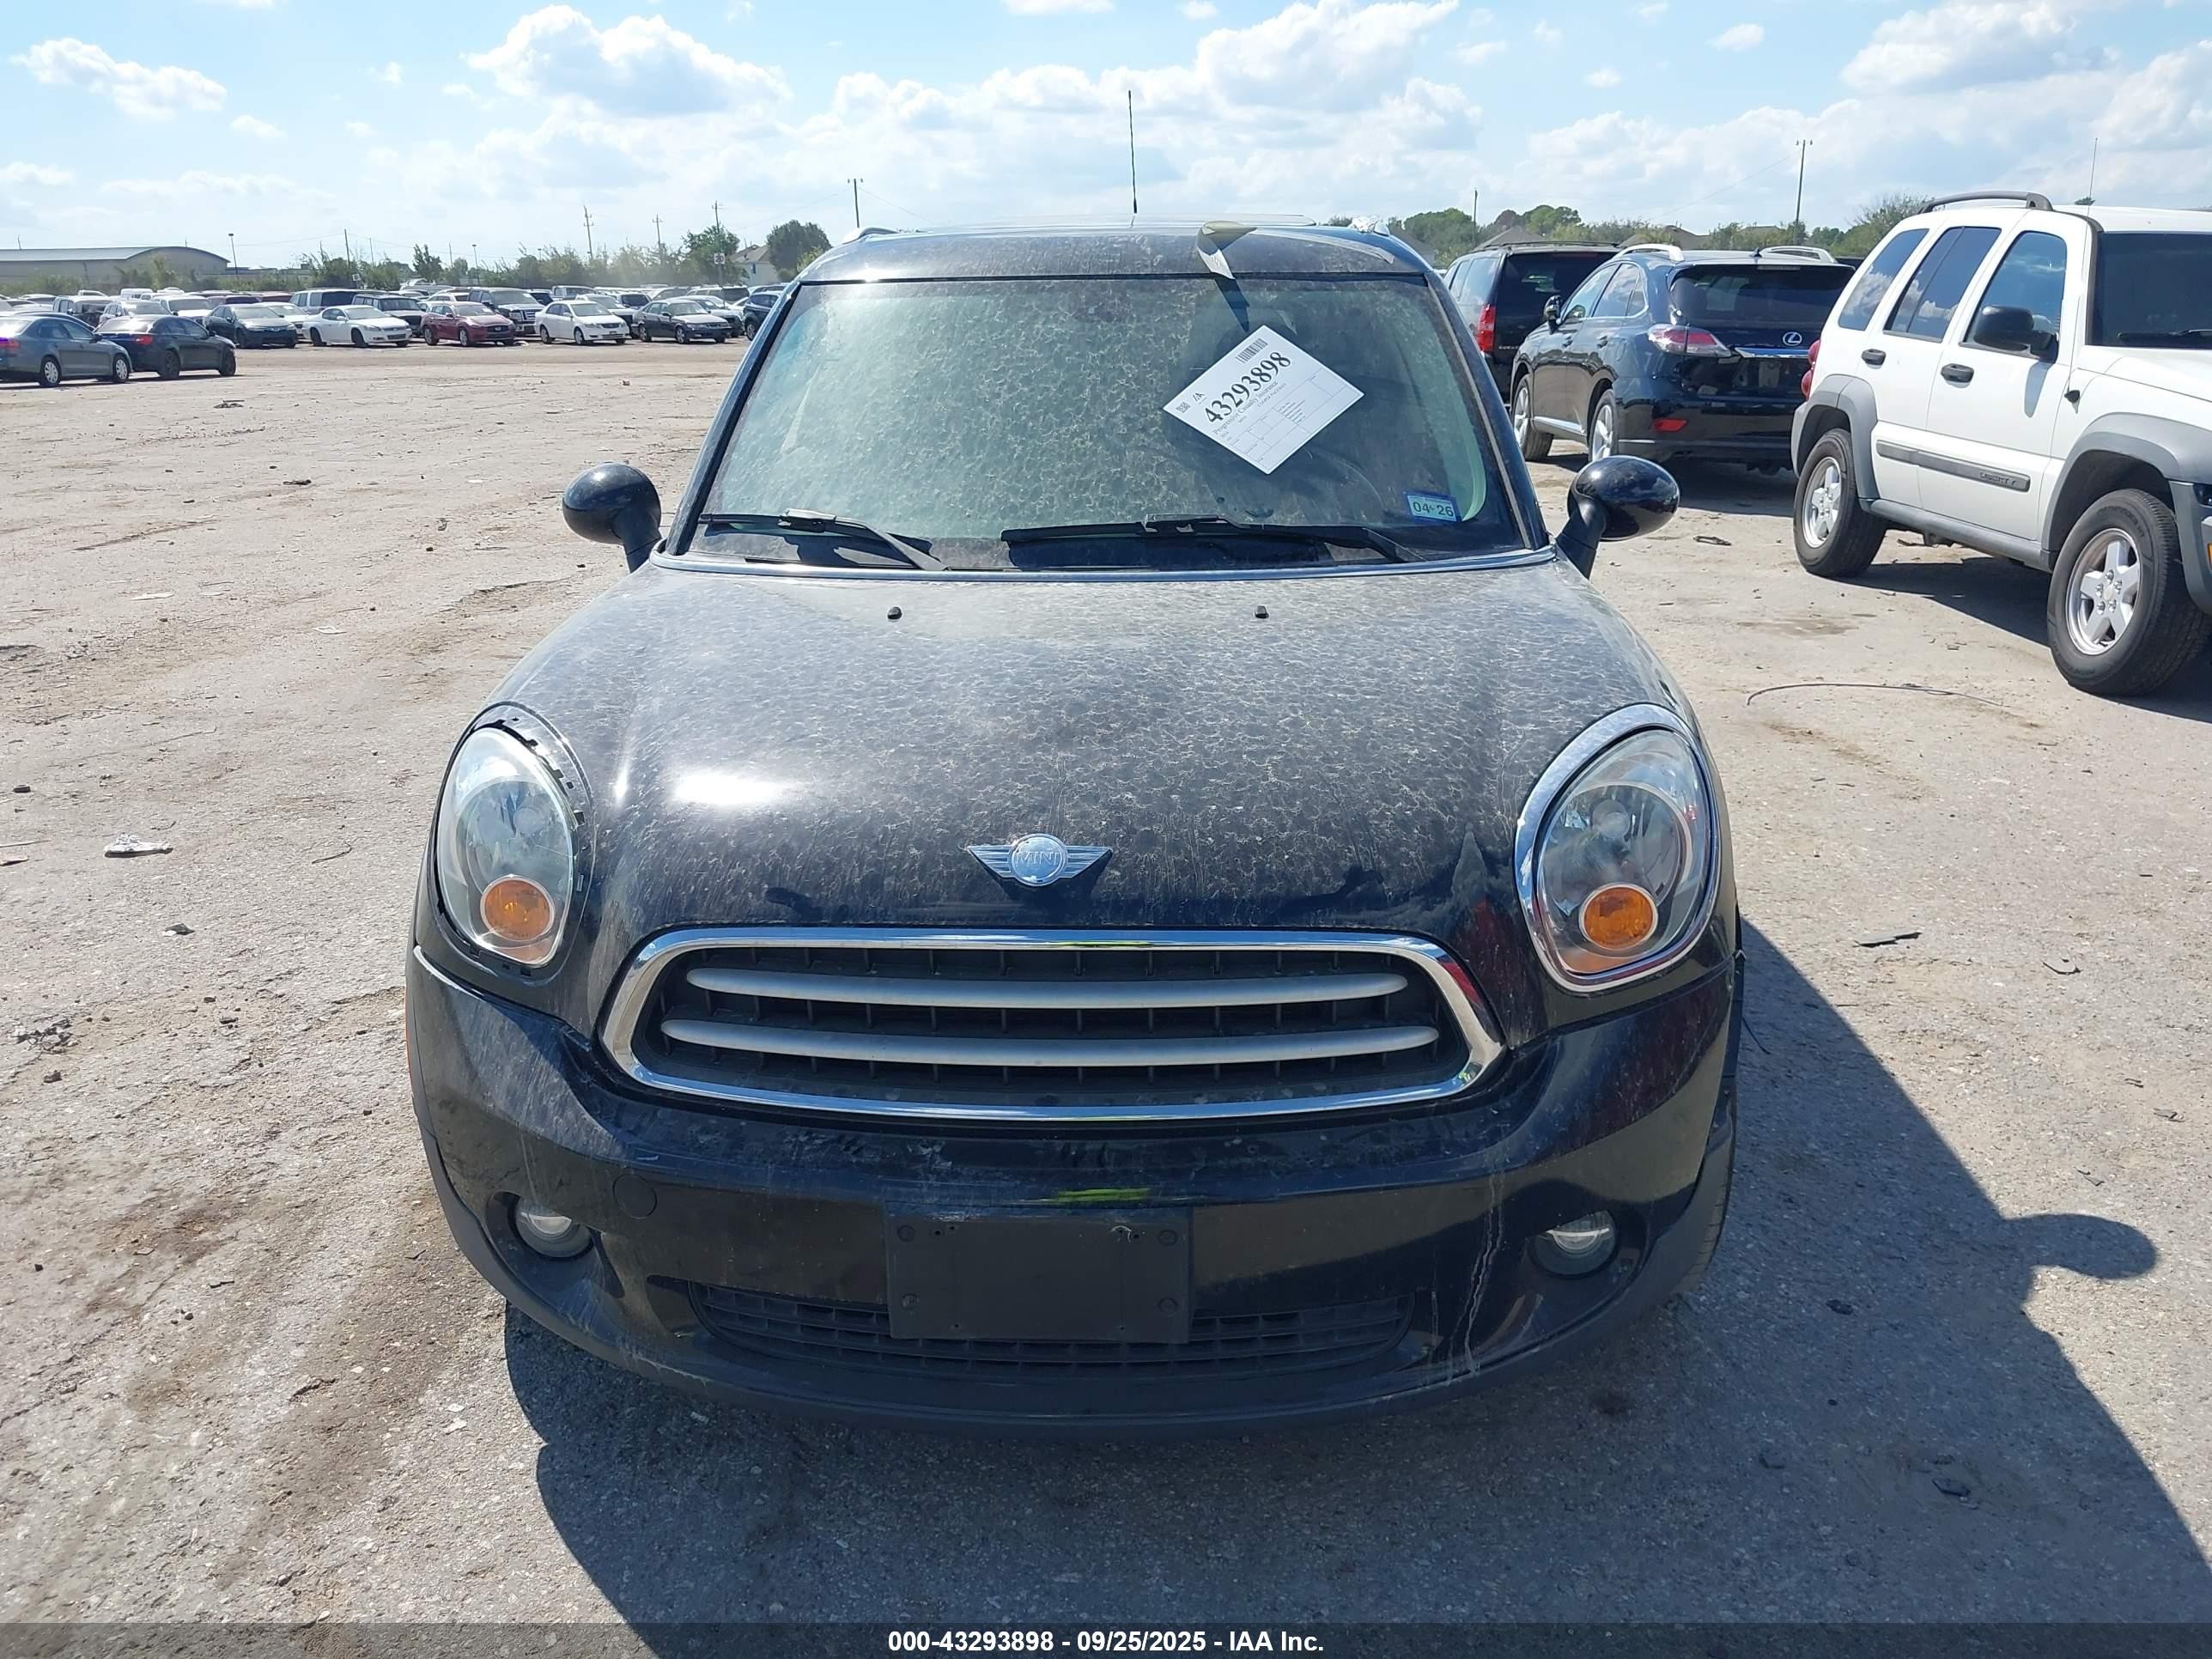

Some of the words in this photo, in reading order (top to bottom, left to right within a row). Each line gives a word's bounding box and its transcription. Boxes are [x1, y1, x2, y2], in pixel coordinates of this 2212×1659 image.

[1205, 352, 1291, 422] 43293898
[1413, 501, 1430, 514] 04
[1436, 504, 1454, 517] 26
[1015, 851, 1059, 866] MINI
